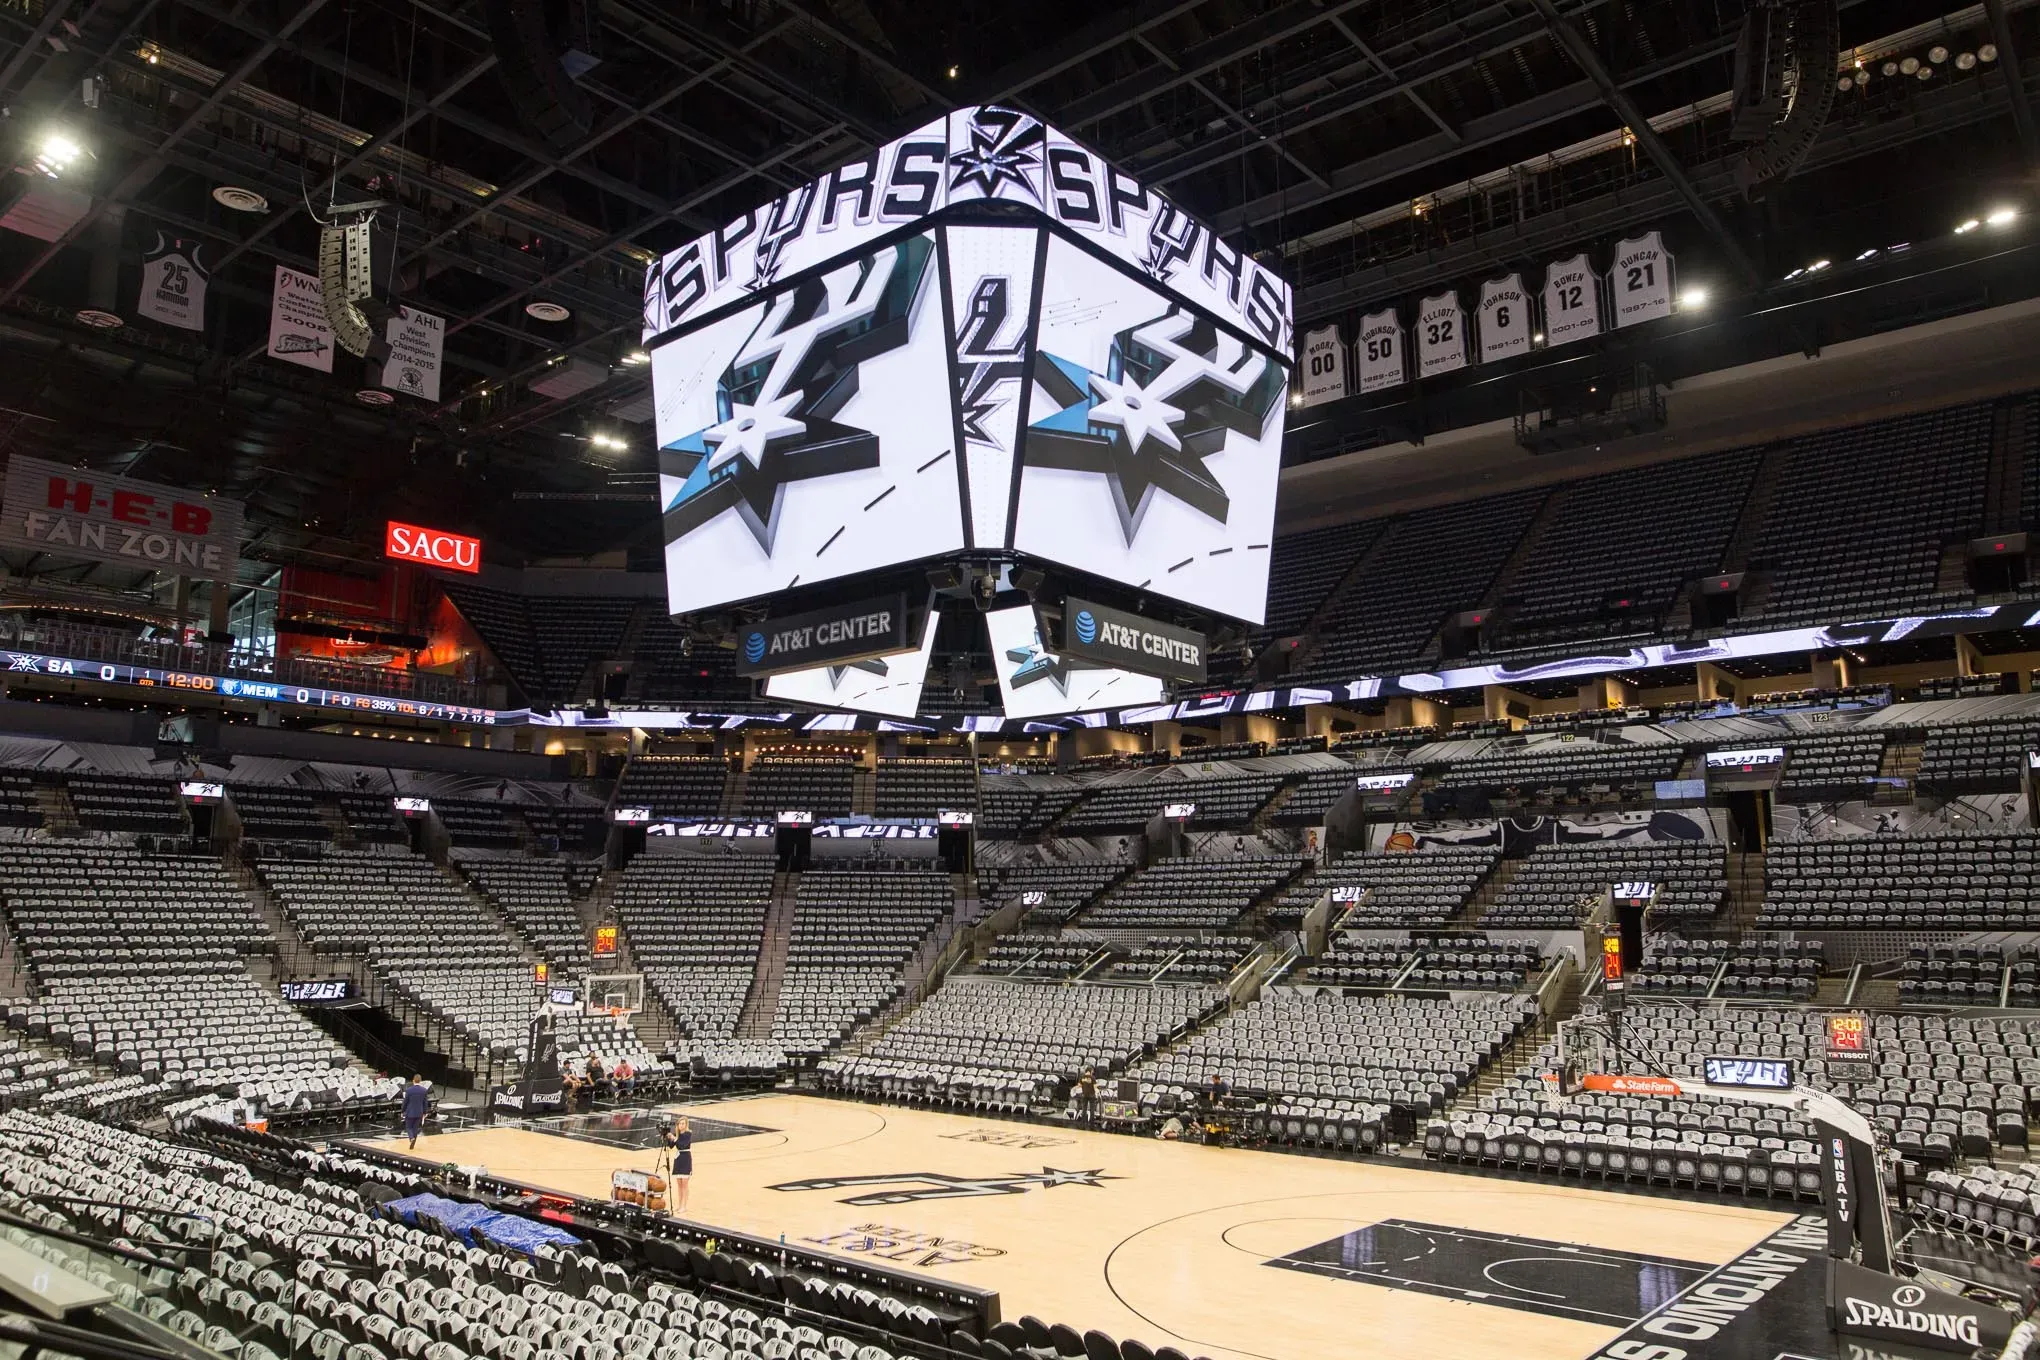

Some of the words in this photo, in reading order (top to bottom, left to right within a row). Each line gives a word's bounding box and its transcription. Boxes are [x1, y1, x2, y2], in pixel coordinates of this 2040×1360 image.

[661, 140, 948, 324] SPURS
[1046, 147, 1285, 350] SPURS
[1620, 250, 1659, 269] DUNCAN
[161, 262, 189, 294] 25
[294, 276, 321, 294] WN
[1553, 273, 1584, 288] BOWEN
[1627, 263, 1655, 292] 21
[1483, 292, 1522, 310] JOHNSON
[1558, 286, 1583, 310] 12
[1621, 298, 1665, 314] 1997-16
[281, 314, 327, 332] 2008
[414, 314, 440, 330] AHL
[1422, 309, 1456, 323] ELLIOTT
[1497, 306, 1510, 328] 6
[406, 326, 426, 338] West
[1361, 326, 1396, 343] ROBINSON
[1428, 320, 1453, 345] 32
[1552, 318, 1594, 334] 2001-09
[393, 340, 435, 358] Champions
[400, 333, 430, 348] Division
[1309, 341, 1336, 355] MOORE
[1487, 337, 1525, 351] 1991-01
[1368, 338, 1392, 361] 50
[391, 352, 435, 370] 2014-2015
[1311, 353, 1334, 376] 00
[1424, 352, 1462, 367] 1989-01
[1363, 370, 1400, 383] 1989-03
[1307, 383, 1342, 396] 1980-90
[24, 511, 106, 549] FAN
[118, 528, 222, 570] ZONE
[391, 527, 478, 567] SACU
[769, 626, 814, 655] AT&T
[816, 611, 891, 645] CENTER
[1100, 621, 1140, 650] AT&T
[1141, 632, 1200, 666] CENTER
[47, 659, 74, 675] SA
[100, 665, 115, 681] 0
[144, 670, 150, 679] 1
[167, 673, 214, 690] 12:00
[242, 681, 278, 698] MEM
[296, 689, 309, 703] 0
[331, 695, 340, 704] F
[341, 695, 350, 706] 0
[355, 698, 371, 708] FG
[371, 700, 396, 711] 39%
[397, 702, 416, 713] TOL
[449, 711, 455, 719] 7
[484, 716, 495, 724] 35
[1813, 713, 1829, 722] 123
[1561, 734, 1575, 742] 122
[597, 938, 614, 952] 24
[1607, 953, 1620, 978] 24
[1832, 1018, 1862, 1031] 12:00
[1836, 1031, 1857, 1047] 24
[1627, 1079, 1650, 1090] State
[1650, 1081, 1674, 1092] Farm
[494, 1092, 524, 1109] SPALDING
[1833, 1158, 1848, 1194] NBA
[1837, 1198, 1850, 1222] TV
[1766, 1215, 1828, 1250] SAN
[1642, 1247, 1809, 1341] ANTONIO
[1844, 1296, 1983, 1348] SPALDING
